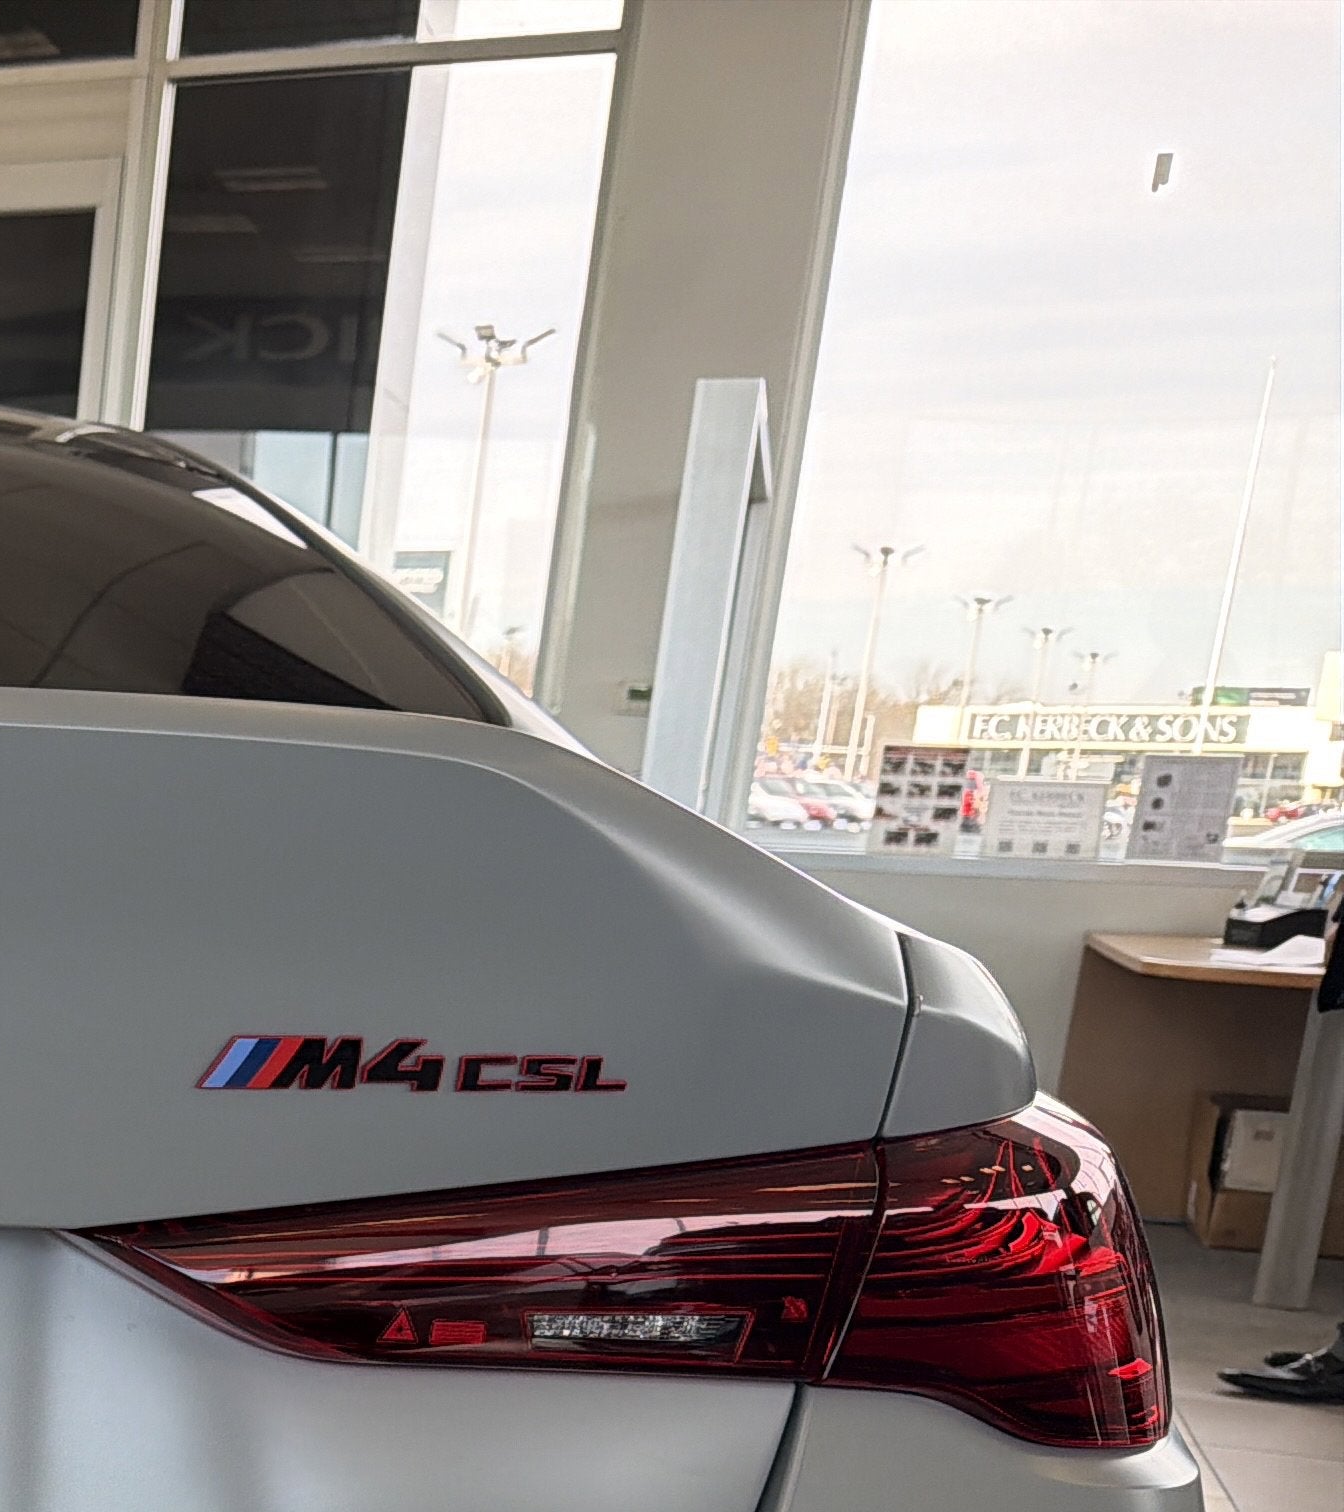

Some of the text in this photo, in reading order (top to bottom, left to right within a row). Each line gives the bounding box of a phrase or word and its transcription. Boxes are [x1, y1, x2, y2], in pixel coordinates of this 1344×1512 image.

[1128, 715, 1152, 743] &
[1155, 715, 1237, 743] SONS
[455, 1053, 628, 1092] CSL
